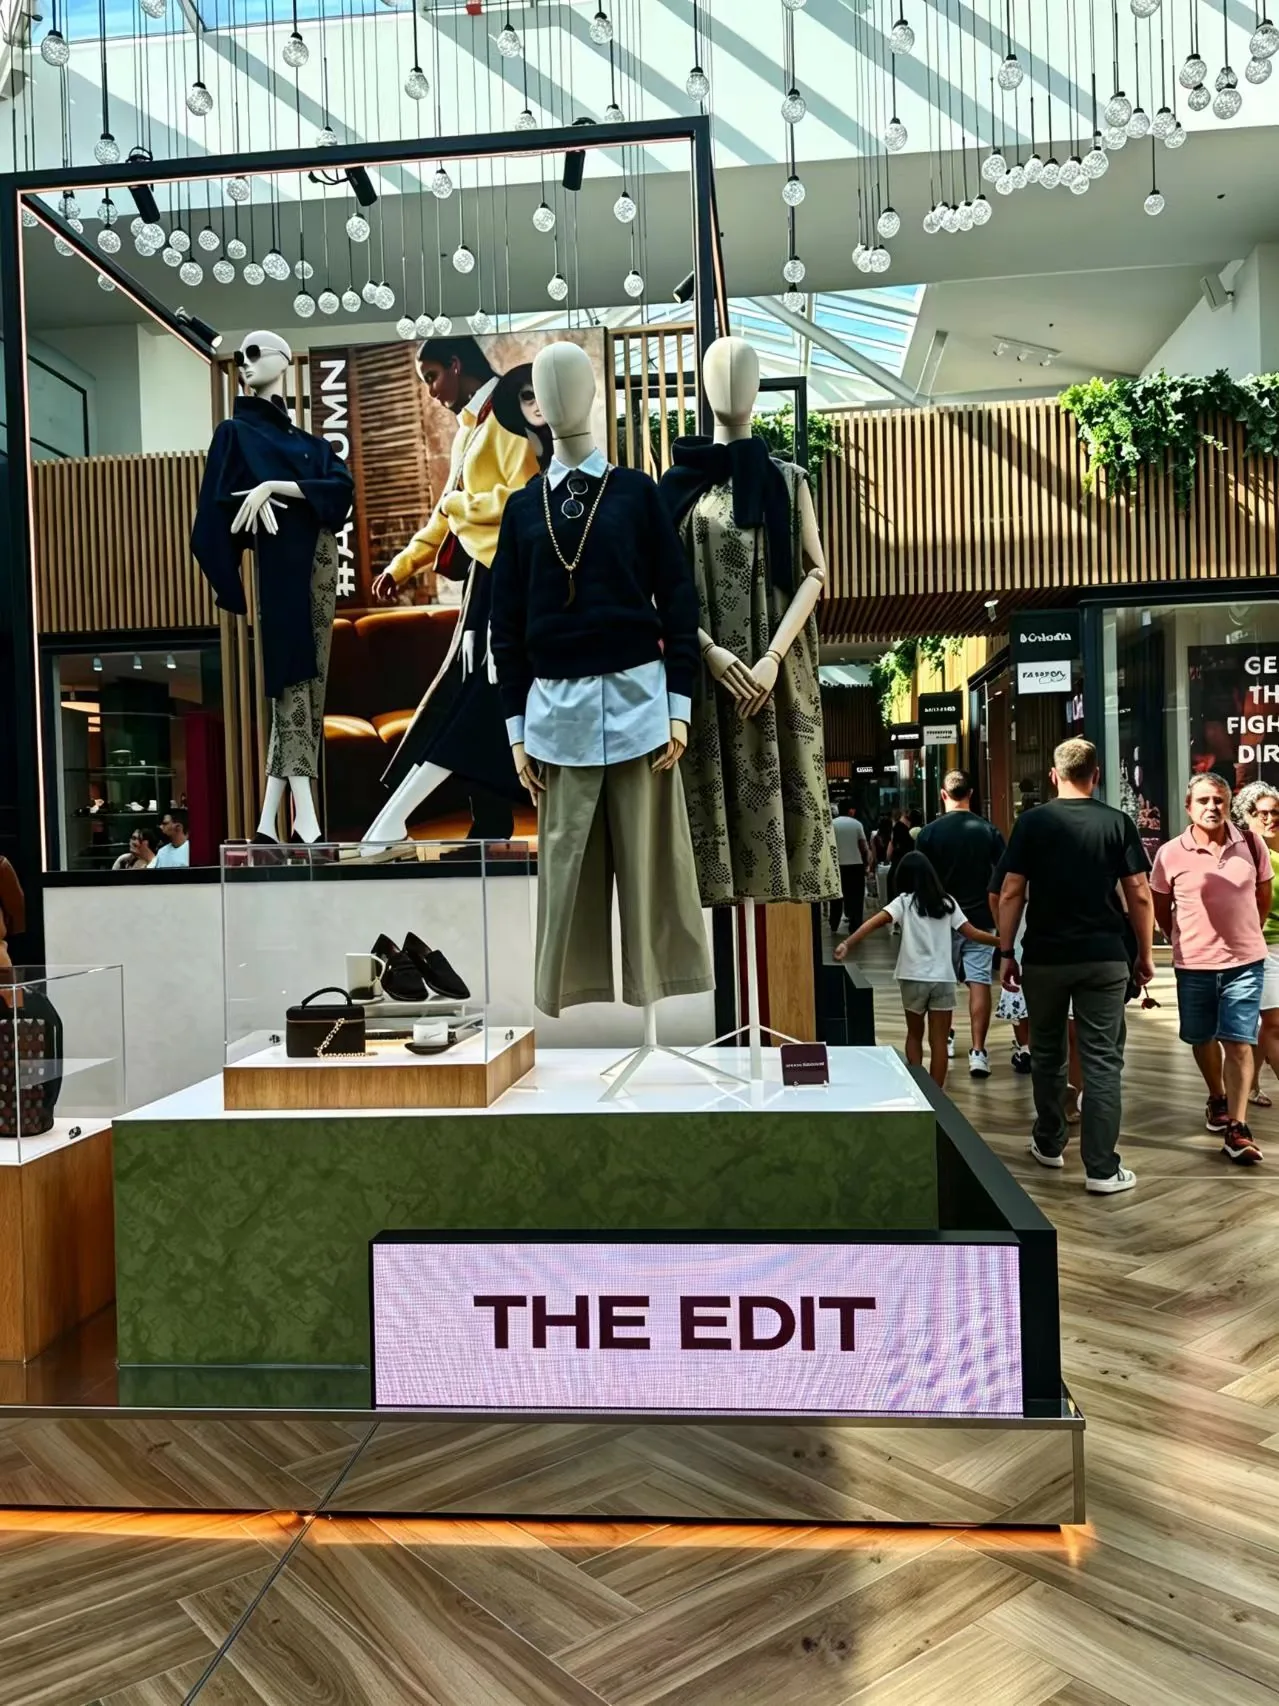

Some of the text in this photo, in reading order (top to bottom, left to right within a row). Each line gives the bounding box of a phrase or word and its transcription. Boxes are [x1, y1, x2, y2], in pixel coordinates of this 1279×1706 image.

[1249, 684, 1279, 704] TH
[1238, 744, 1279, 764] DIR
[473, 1295, 876, 1352] THE EDIT
